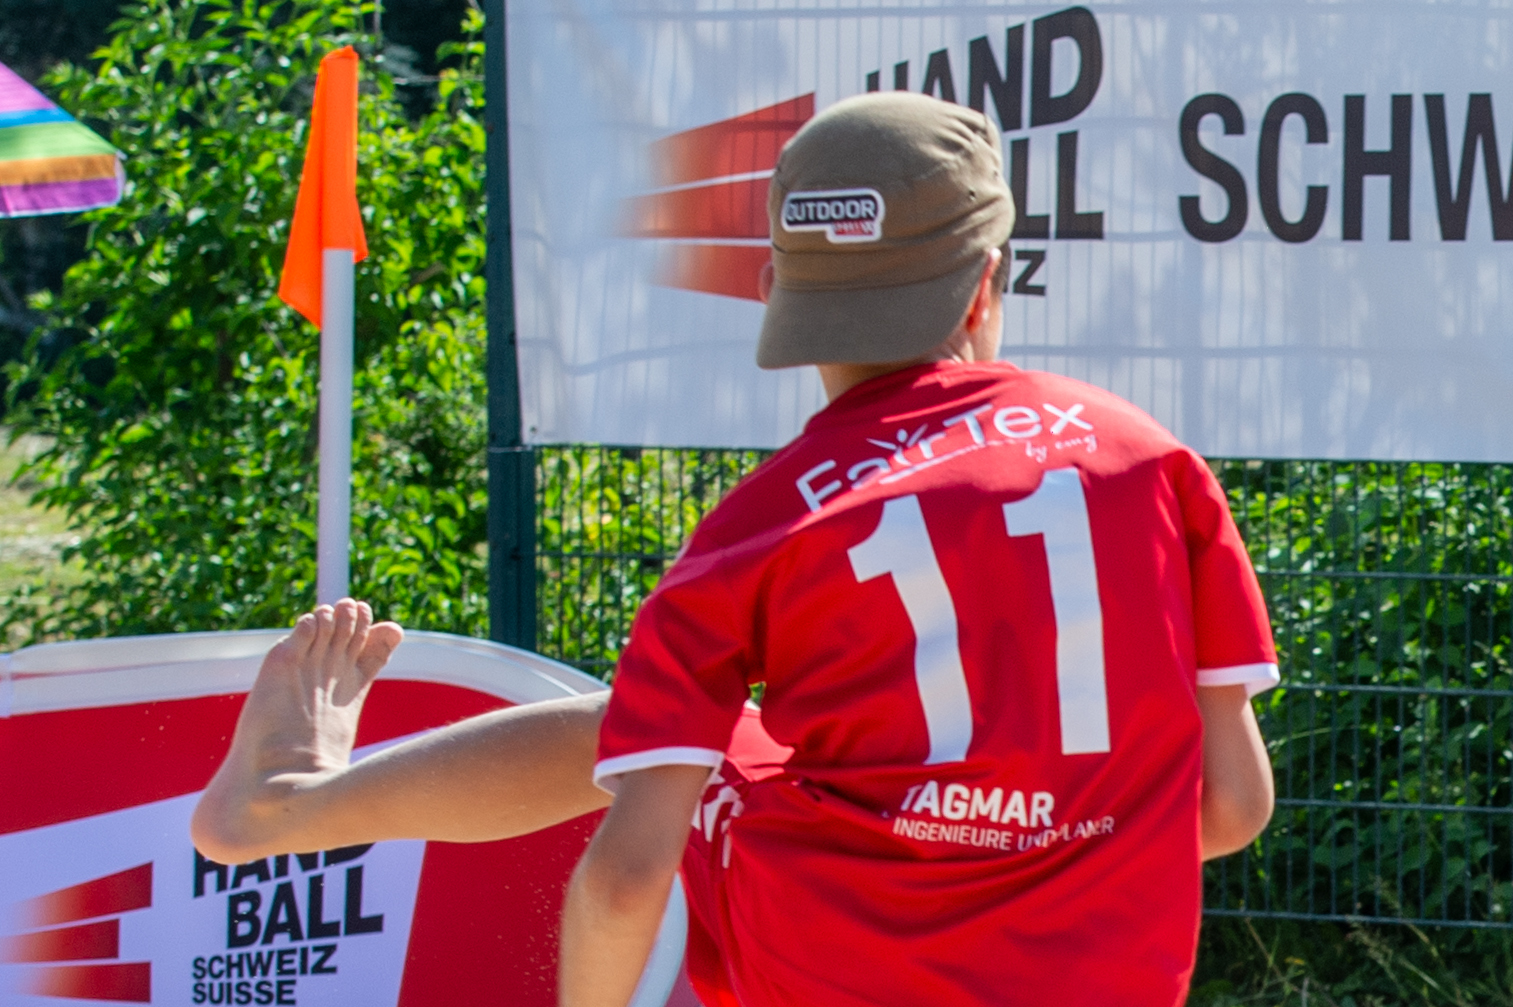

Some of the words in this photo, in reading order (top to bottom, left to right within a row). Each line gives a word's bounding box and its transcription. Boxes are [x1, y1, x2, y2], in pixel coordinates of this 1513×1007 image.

[796, 403, 1094, 512] FairTex
[847, 467, 1111, 765] 11
[901, 780, 1055, 828] TAGMAR
[893, 816, 1013, 851] INGENIEURE
[227, 864, 384, 949] BALL
[192, 943, 338, 979] SCHWEIZ
[192, 979, 297, 1006] SUISSE
